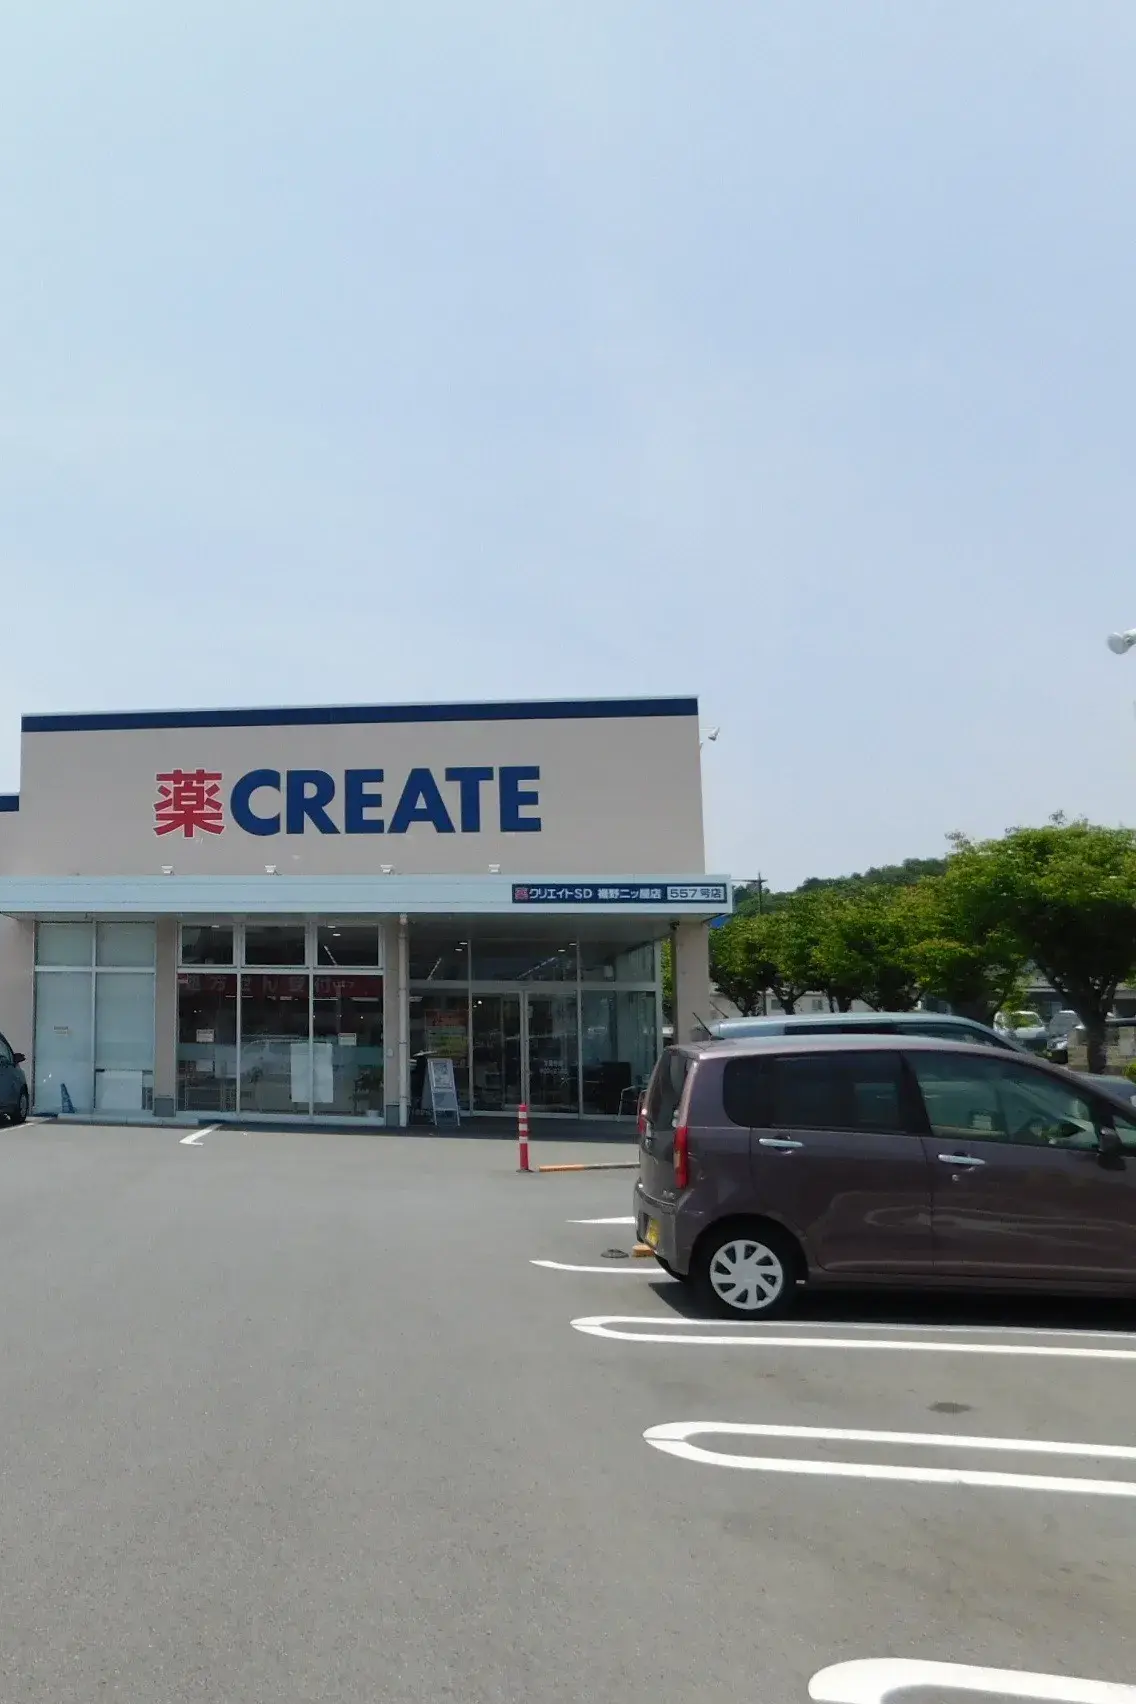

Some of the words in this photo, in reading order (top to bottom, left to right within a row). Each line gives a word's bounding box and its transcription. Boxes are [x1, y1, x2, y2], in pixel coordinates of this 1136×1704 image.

[152, 768, 225, 838] 薬
[230, 766, 542, 837] CREATE
[529, 888, 593, 900] クリエイトSD
